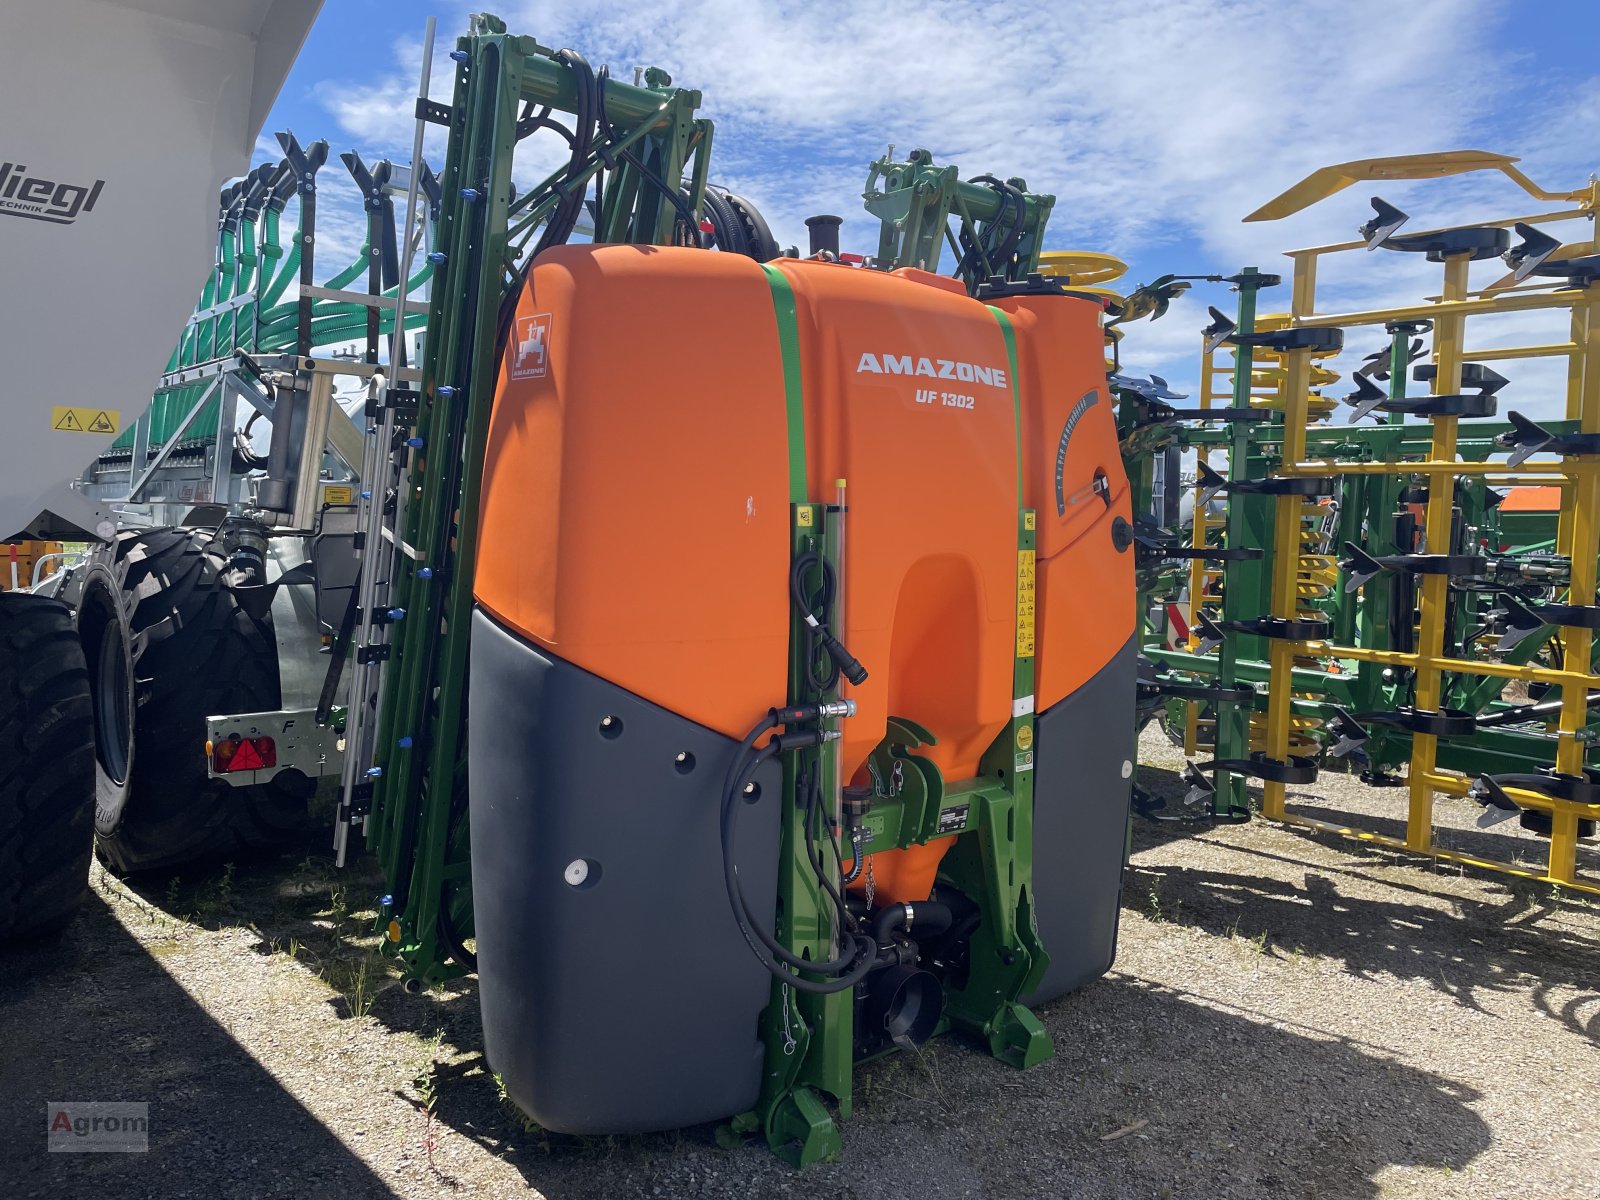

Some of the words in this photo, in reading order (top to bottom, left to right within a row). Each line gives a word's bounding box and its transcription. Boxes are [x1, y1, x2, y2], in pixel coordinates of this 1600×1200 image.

[514, 368, 544, 377] AMAZONE
[857, 353, 1007, 388] AMAZONE
[915, 389, 937, 403] UF
[941, 392, 975, 409] 1302
